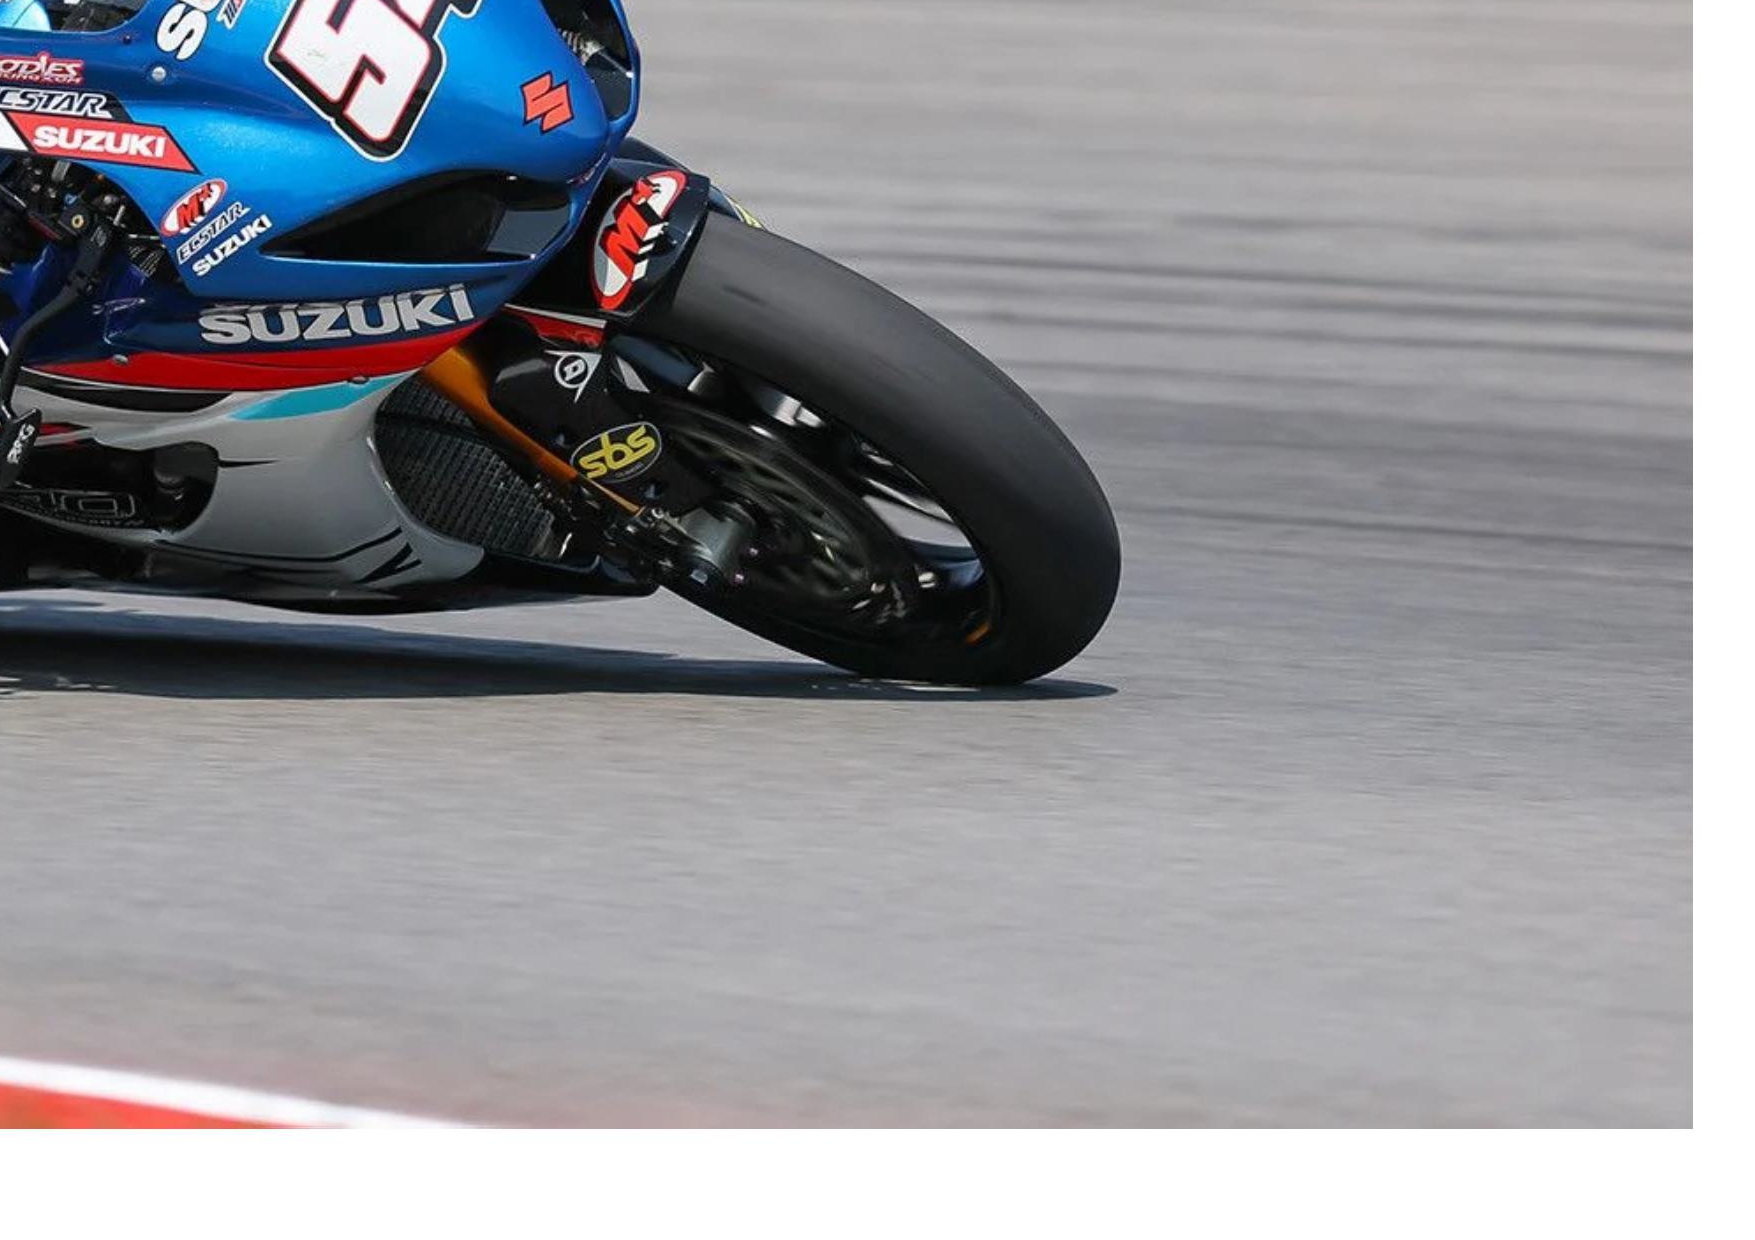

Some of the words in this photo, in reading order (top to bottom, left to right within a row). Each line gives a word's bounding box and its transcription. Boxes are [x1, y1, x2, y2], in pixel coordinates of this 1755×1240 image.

[33, 125, 167, 159] SUZUKI
[176, 201, 252, 265] ECSTAR
[192, 214, 273, 276] SUZUKI
[198, 282, 476, 345] SUZUKI
[578, 424, 656, 479] sbs
